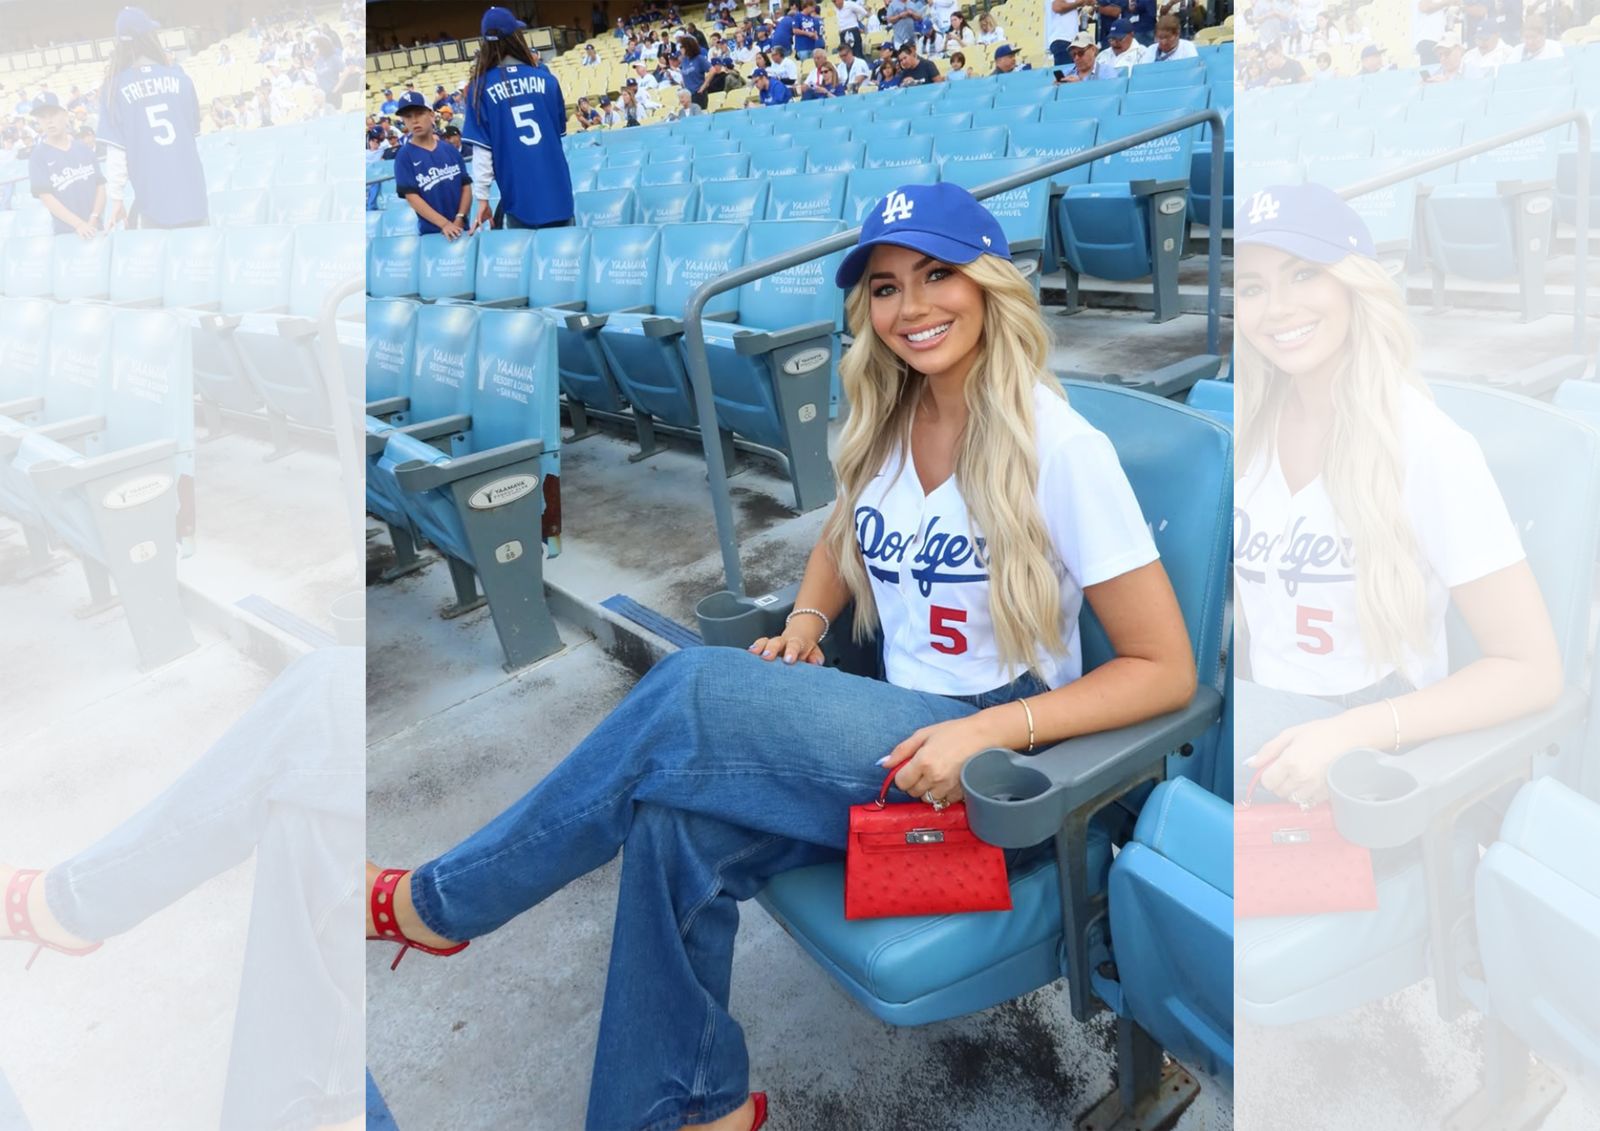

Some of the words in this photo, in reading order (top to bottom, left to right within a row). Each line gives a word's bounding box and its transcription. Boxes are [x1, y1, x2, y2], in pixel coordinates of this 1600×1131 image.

[121, 76, 179, 104] FREEMAN
[487, 76, 545, 104] FREEMAN
[145, 103, 176, 146] 5
[511, 103, 542, 146] 5
[1155, 146, 1181, 154] CASINO
[882, 190, 914, 224] LA
[1248, 190, 1280, 224] LA
[771, 276, 796, 285] RESORT
[802, 277, 825, 285] CASINO
[930, 605, 967, 655] 5
[1296, 605, 1333, 655] 5
